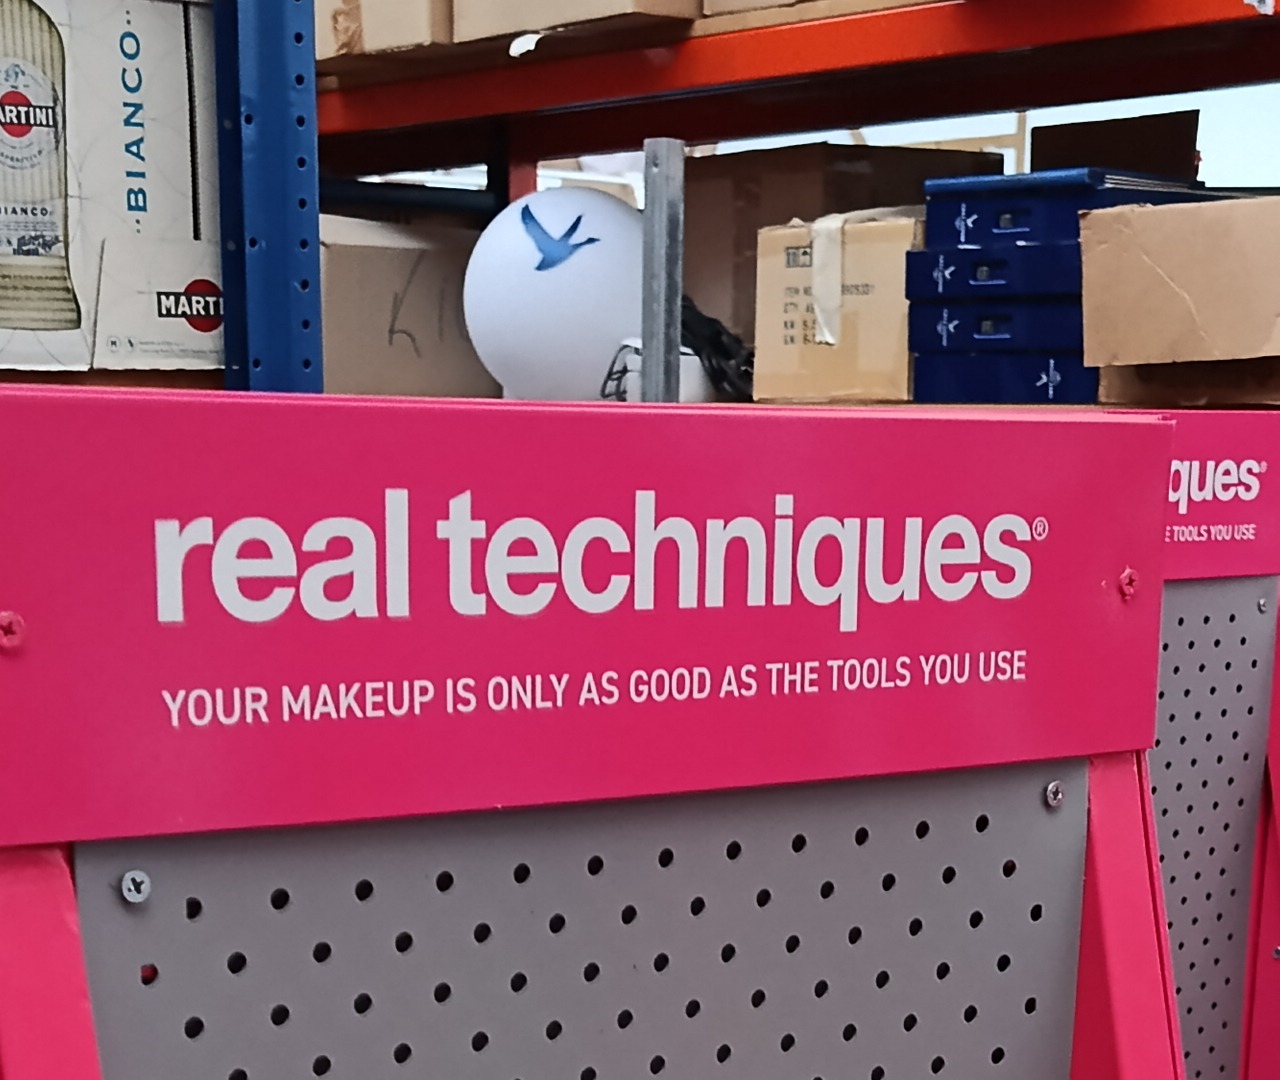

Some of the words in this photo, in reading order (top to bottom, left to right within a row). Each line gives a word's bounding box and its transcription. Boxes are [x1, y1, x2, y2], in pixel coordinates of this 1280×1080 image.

[120, 31, 148, 213] BIANCO
[155, 488, 409, 623] real
[1173, 525, 1208, 542] TOOLS
[1210, 525, 1233, 541] YOU
[1234, 524, 1257, 540] USE
[162, 687, 269, 728] YOUR
[281, 680, 435, 722] MAKEUP
[446, 677, 477, 714] IS
[488, 674, 570, 711] ONLY
[579, 671, 620, 707] AS
[630, 667, 711, 703] GOOD
[720, 664, 758, 698] AS
[766, 661, 819, 695] THE
[826, 655, 912, 692] TOOLS
[920, 653, 971, 686] YOU
[979, 651, 1027, 682] USE
